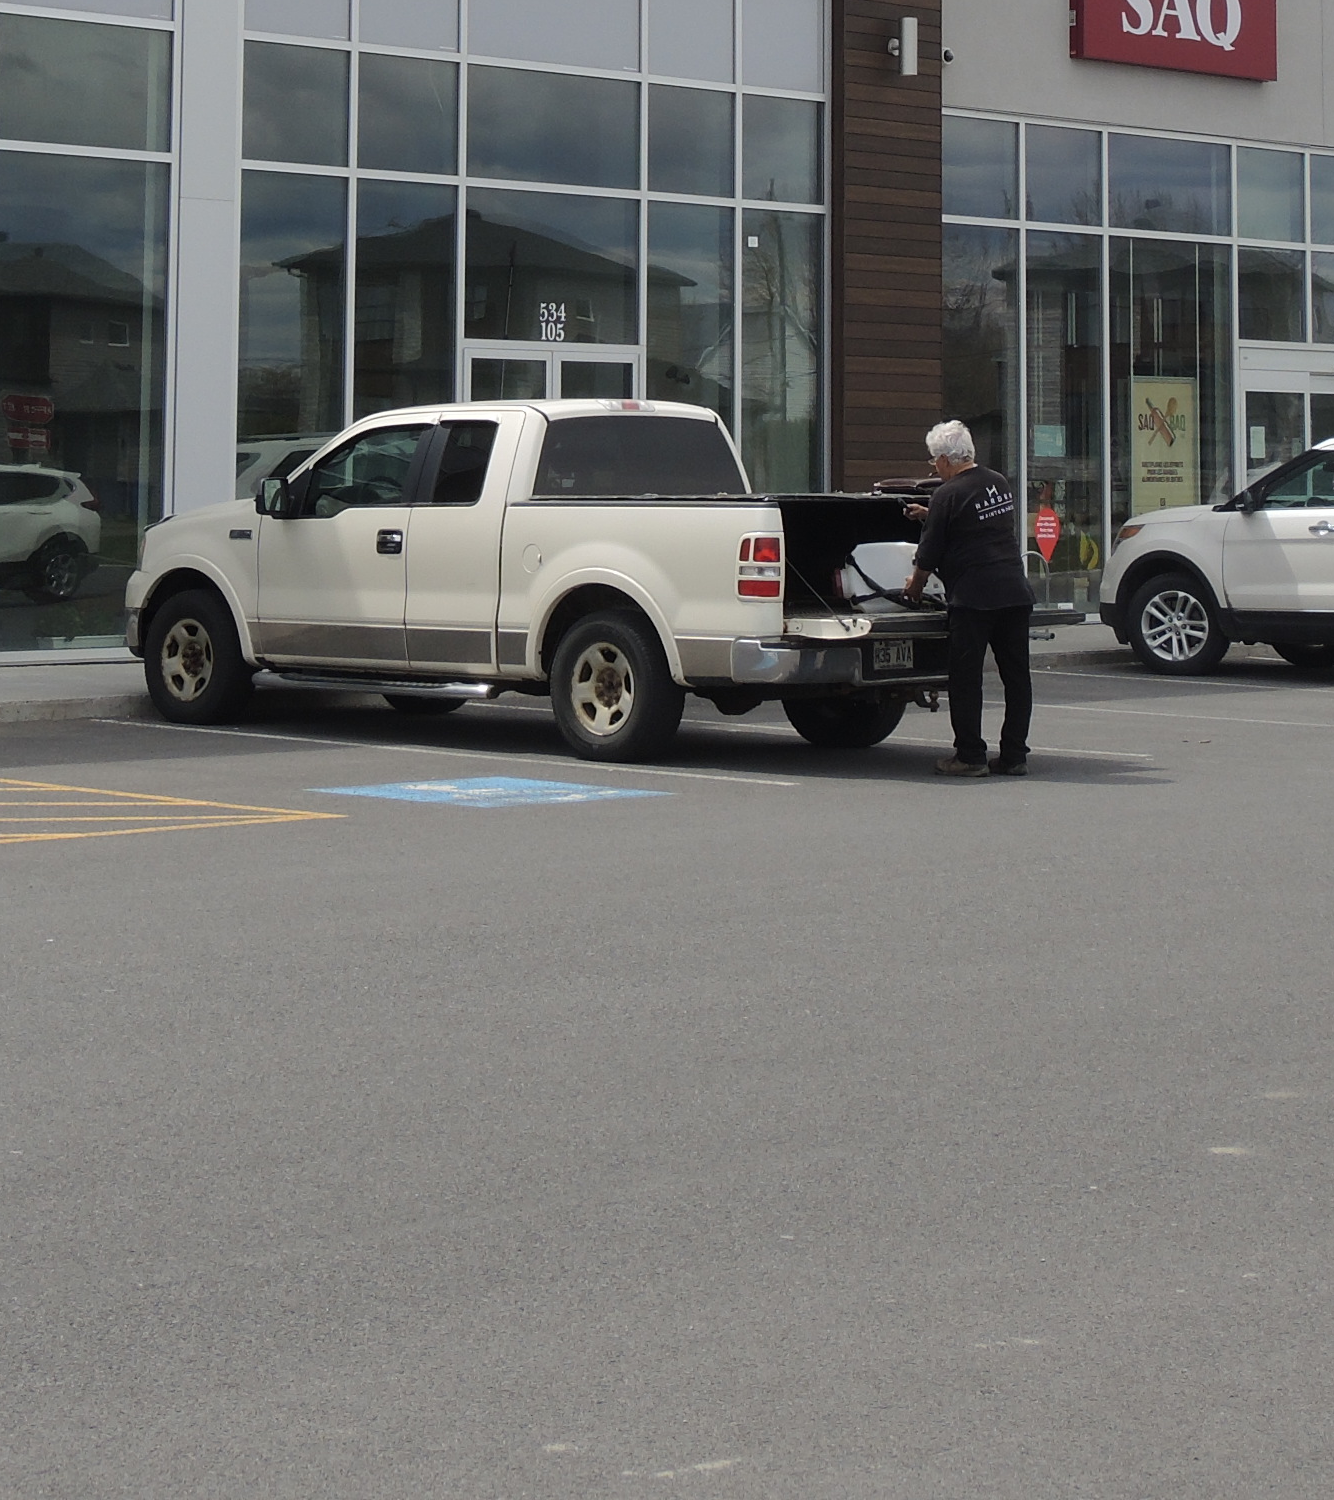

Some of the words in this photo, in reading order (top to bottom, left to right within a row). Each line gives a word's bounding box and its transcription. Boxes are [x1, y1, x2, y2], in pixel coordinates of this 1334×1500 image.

[539, 302, 566, 321] 534
[540, 322, 565, 341] 105
[1138, 414, 1155, 431] SAQ
